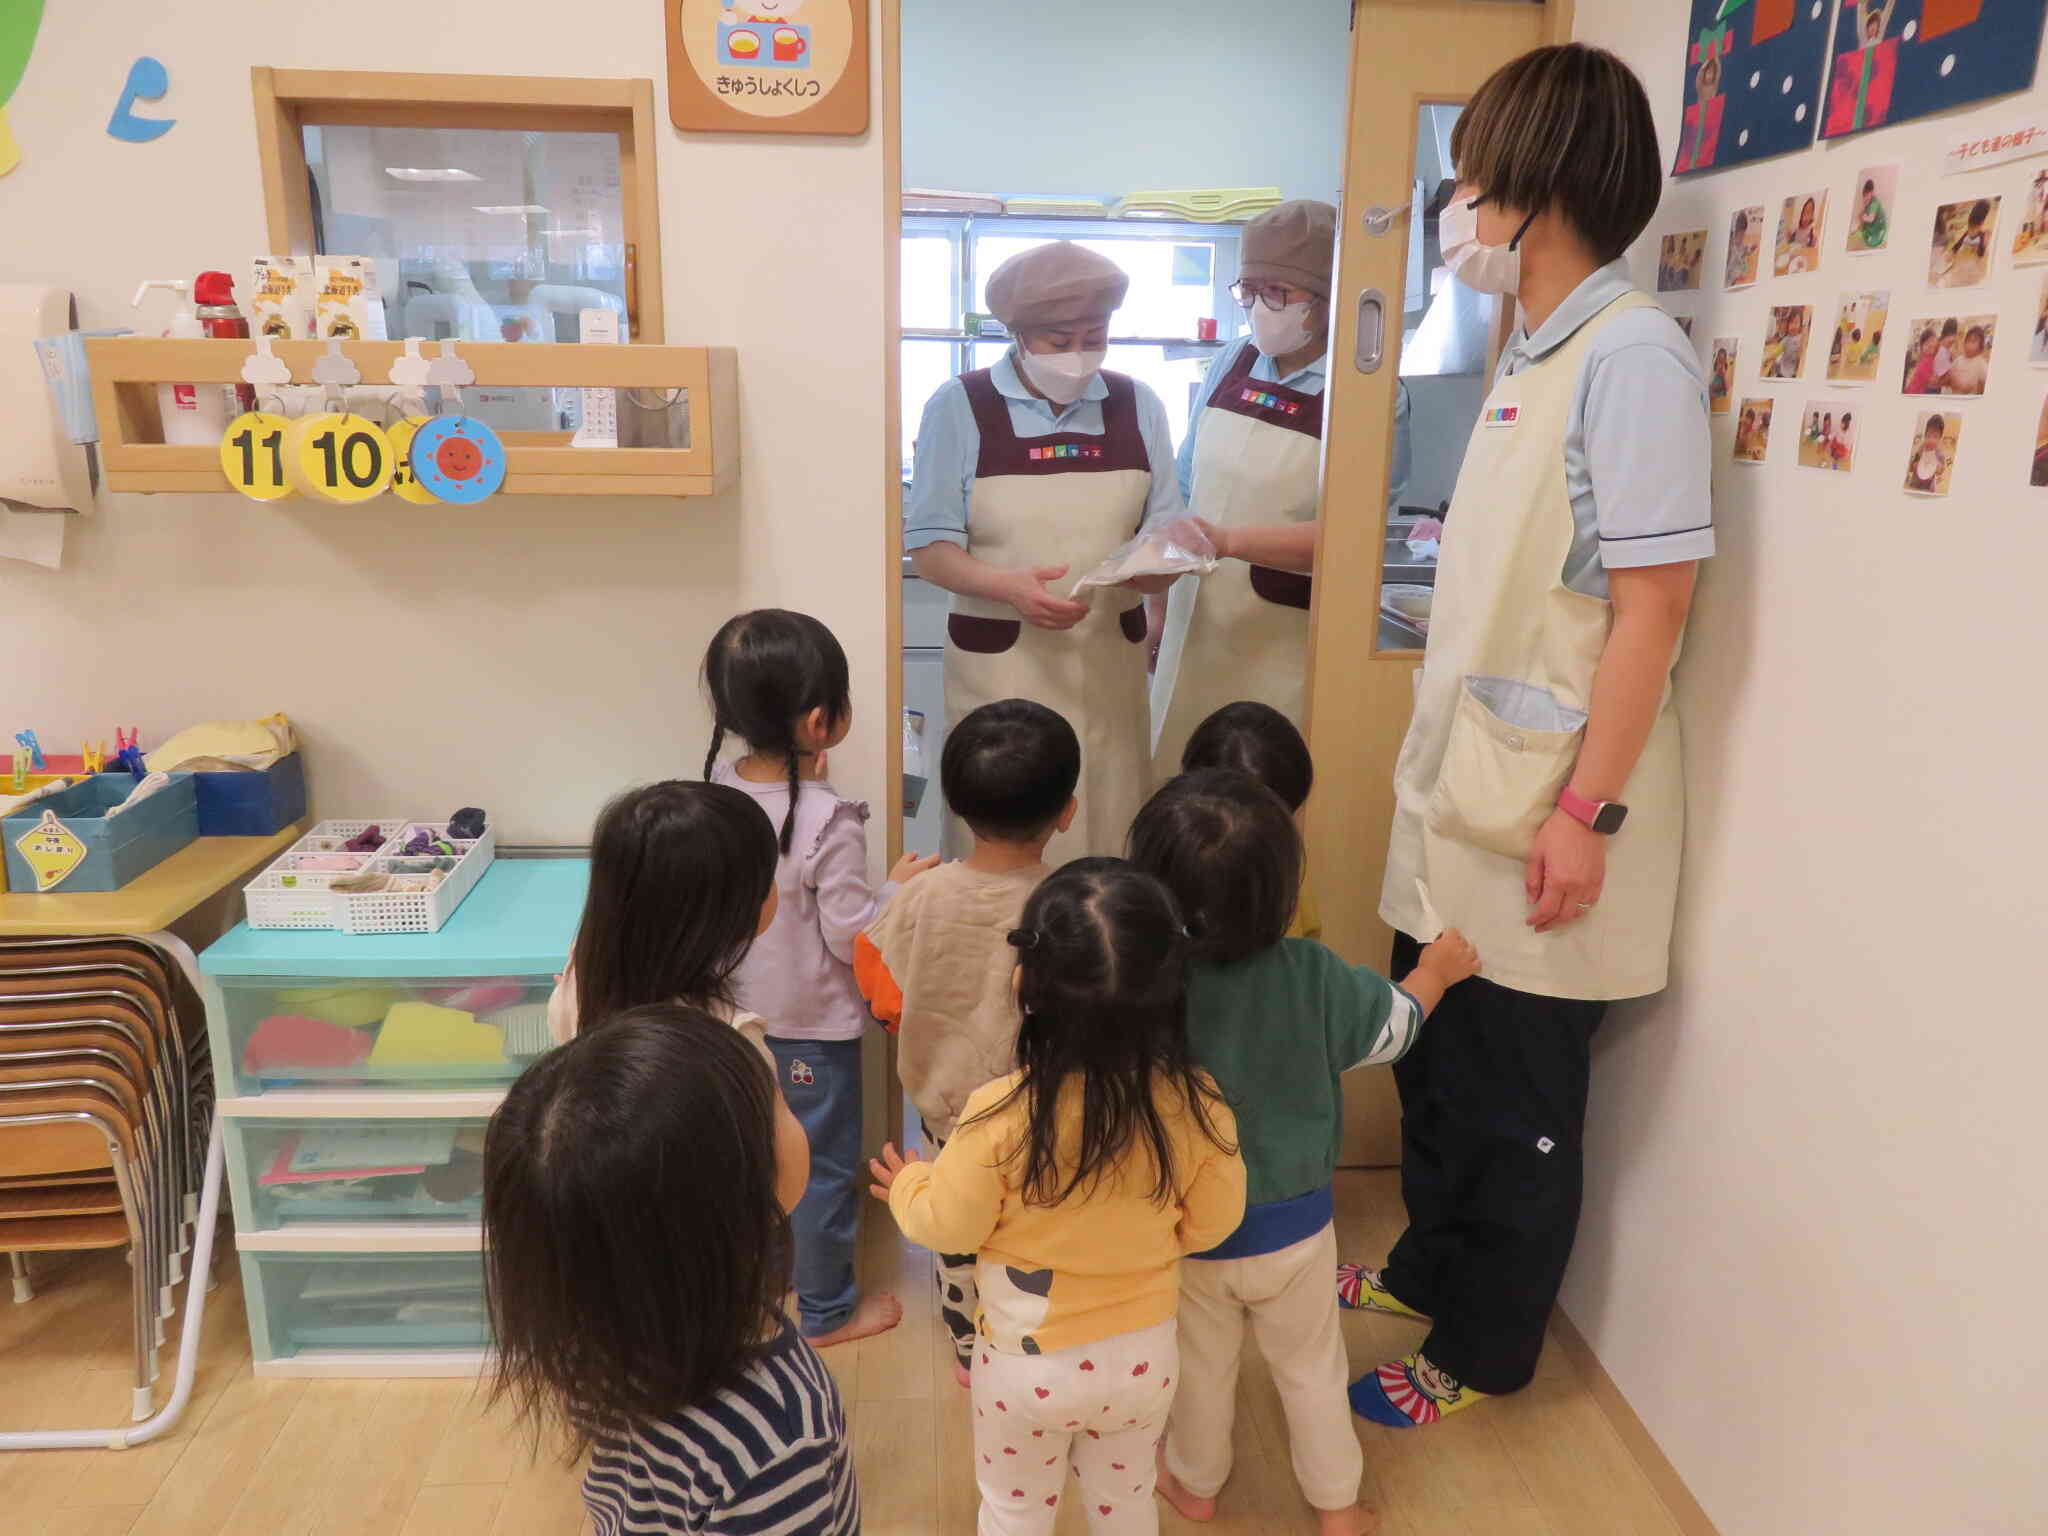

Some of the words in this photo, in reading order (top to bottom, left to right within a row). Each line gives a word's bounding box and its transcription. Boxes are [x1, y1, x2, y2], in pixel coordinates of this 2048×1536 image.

[717, 75, 820, 97] きゅうしょくしつ
[232, 430, 283, 486] 11
[312, 431, 382, 488] 10
